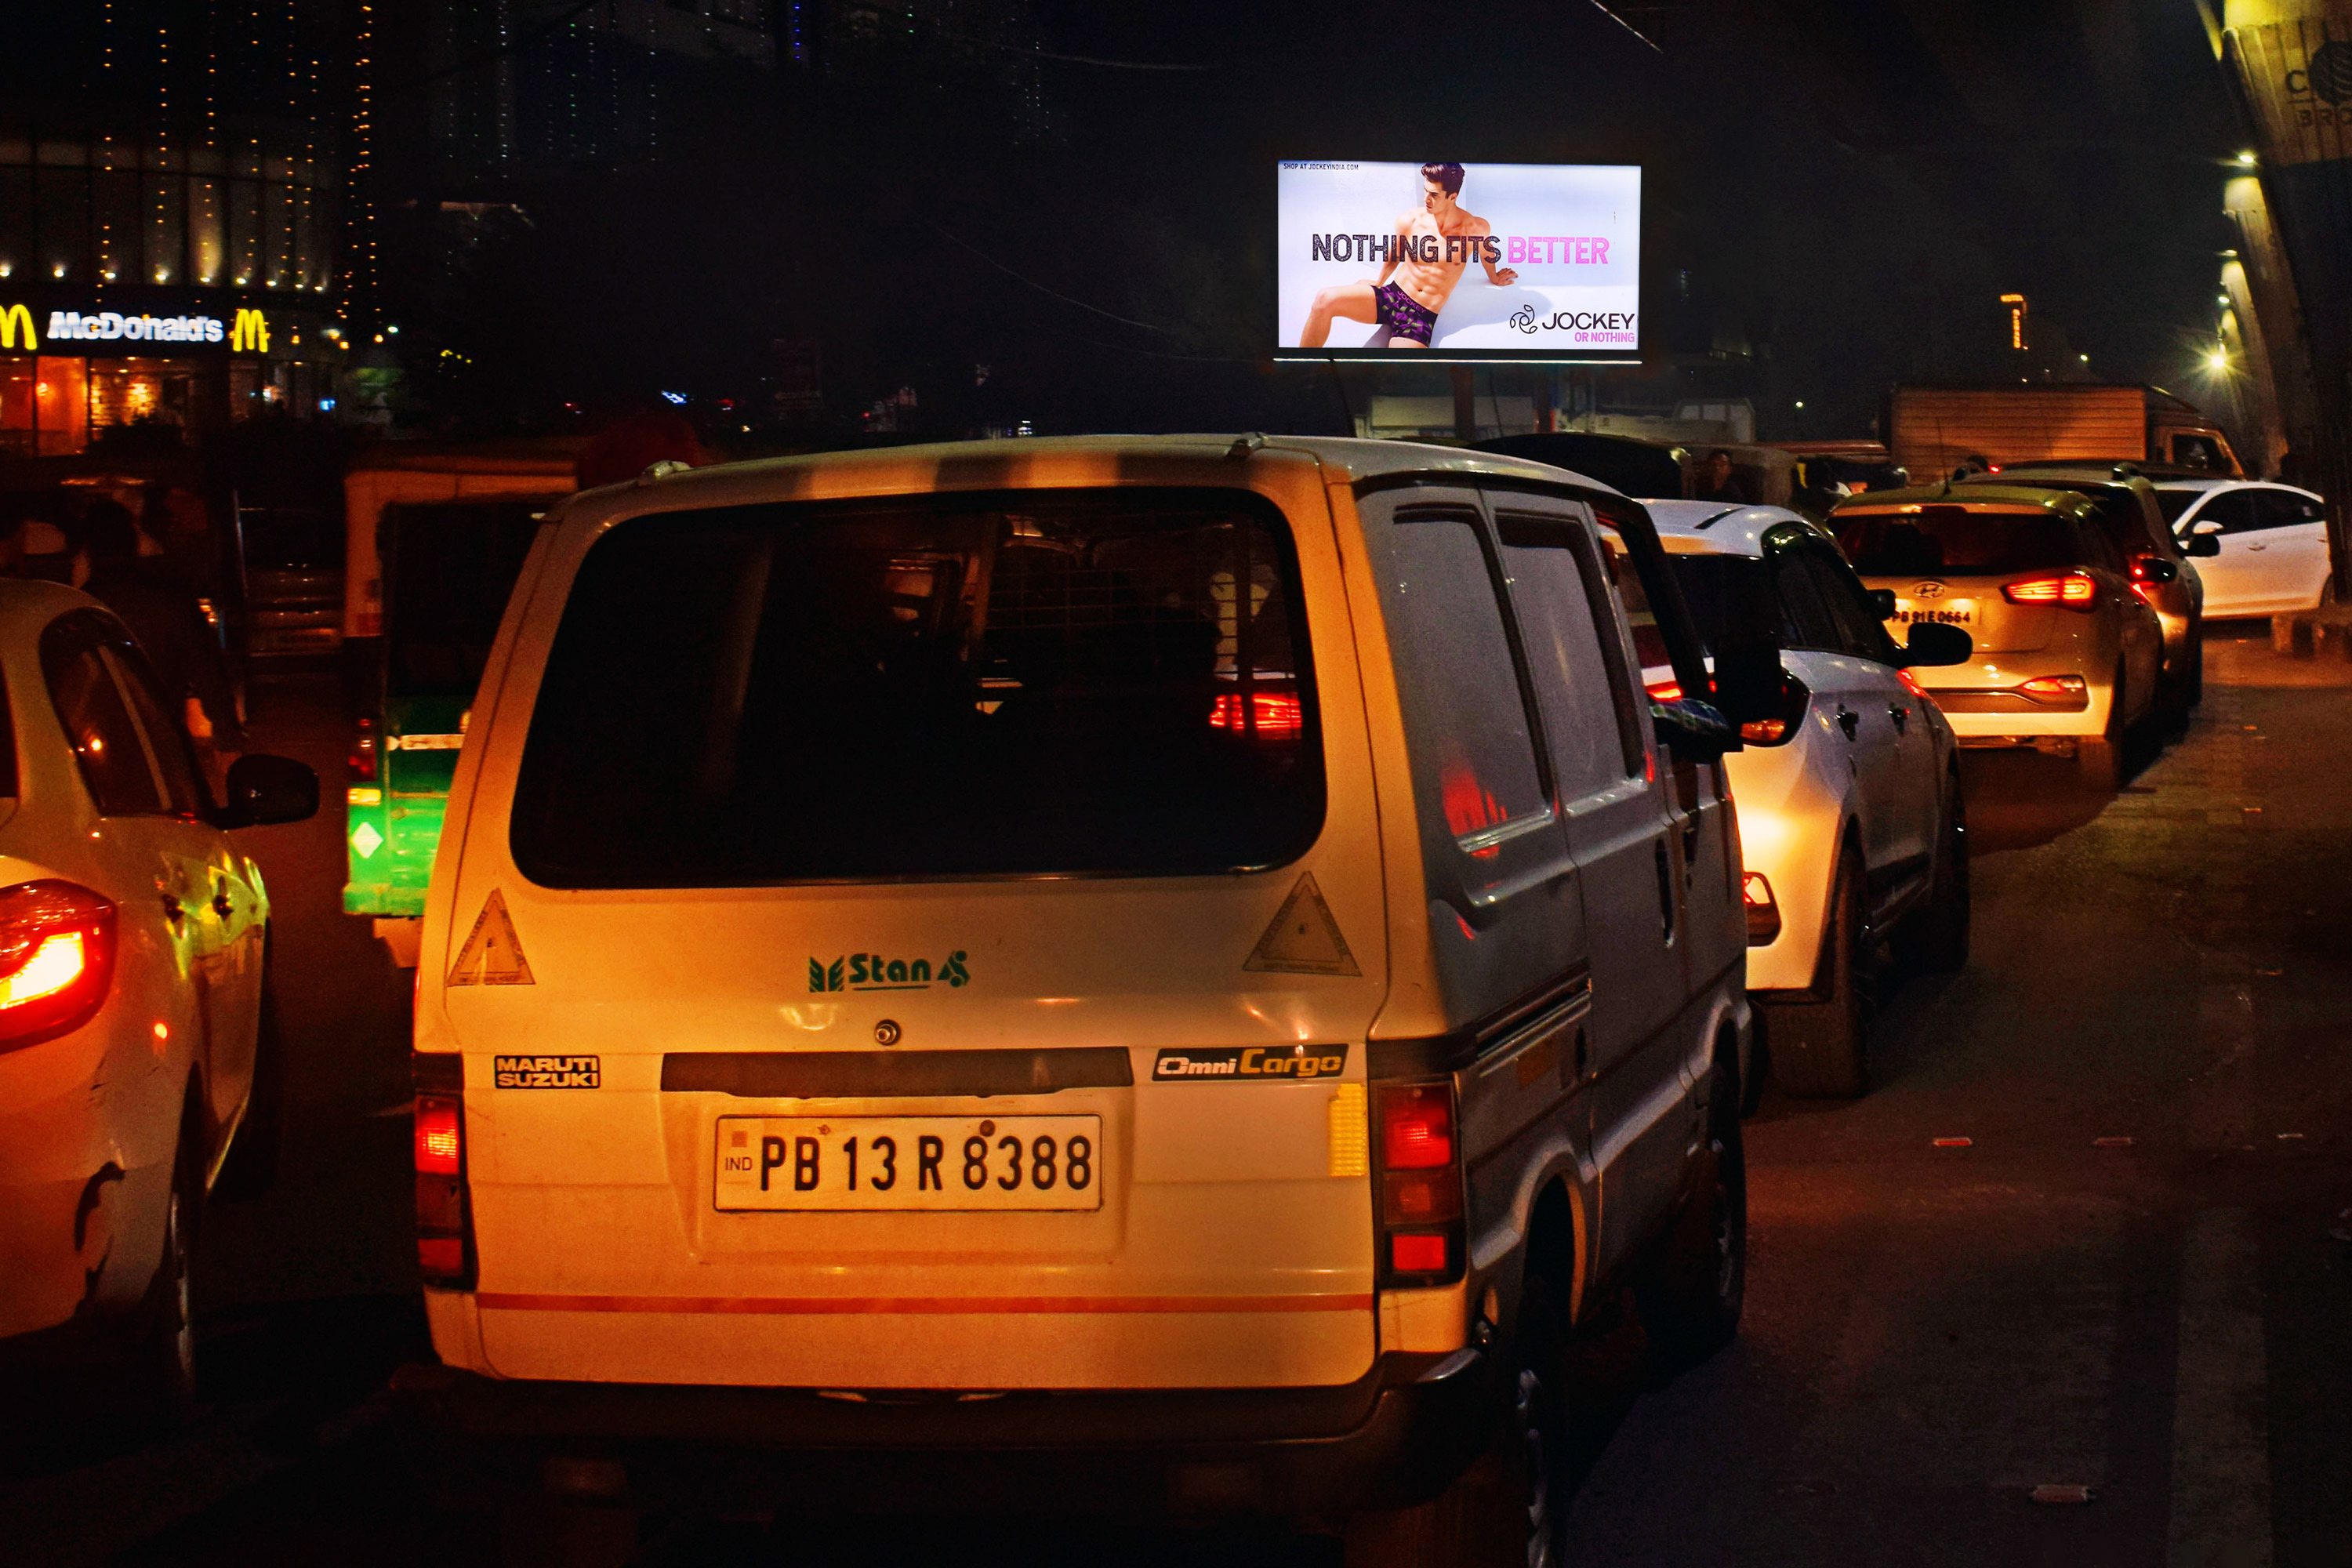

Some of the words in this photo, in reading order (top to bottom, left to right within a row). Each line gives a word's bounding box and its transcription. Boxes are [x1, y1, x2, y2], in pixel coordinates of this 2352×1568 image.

[1312, 234, 1439, 263] NOTHING
[1446, 235, 1501, 263] FITS
[1508, 236, 1610, 264] BETTER
[1396, 290, 1427, 314] JOCKEY
[47, 311, 224, 342] McDonald's
[1541, 312, 1635, 330] JOCKEY
[1574, 332, 1589, 343] OR
[1591, 332, 1635, 343] NOTHING
[496, 1058, 598, 1072] MARUTI
[1156, 1056, 1237, 1075] Omni
[1240, 1048, 1342, 1078] Cargo
[497, 1073, 598, 1087] SUZUKI
[724, 1157, 753, 1171] IND
[760, 1135, 820, 1191] PB
[843, 1135, 897, 1191] 13
[918, 1135, 944, 1191] R
[964, 1134, 1092, 1191] 8388
